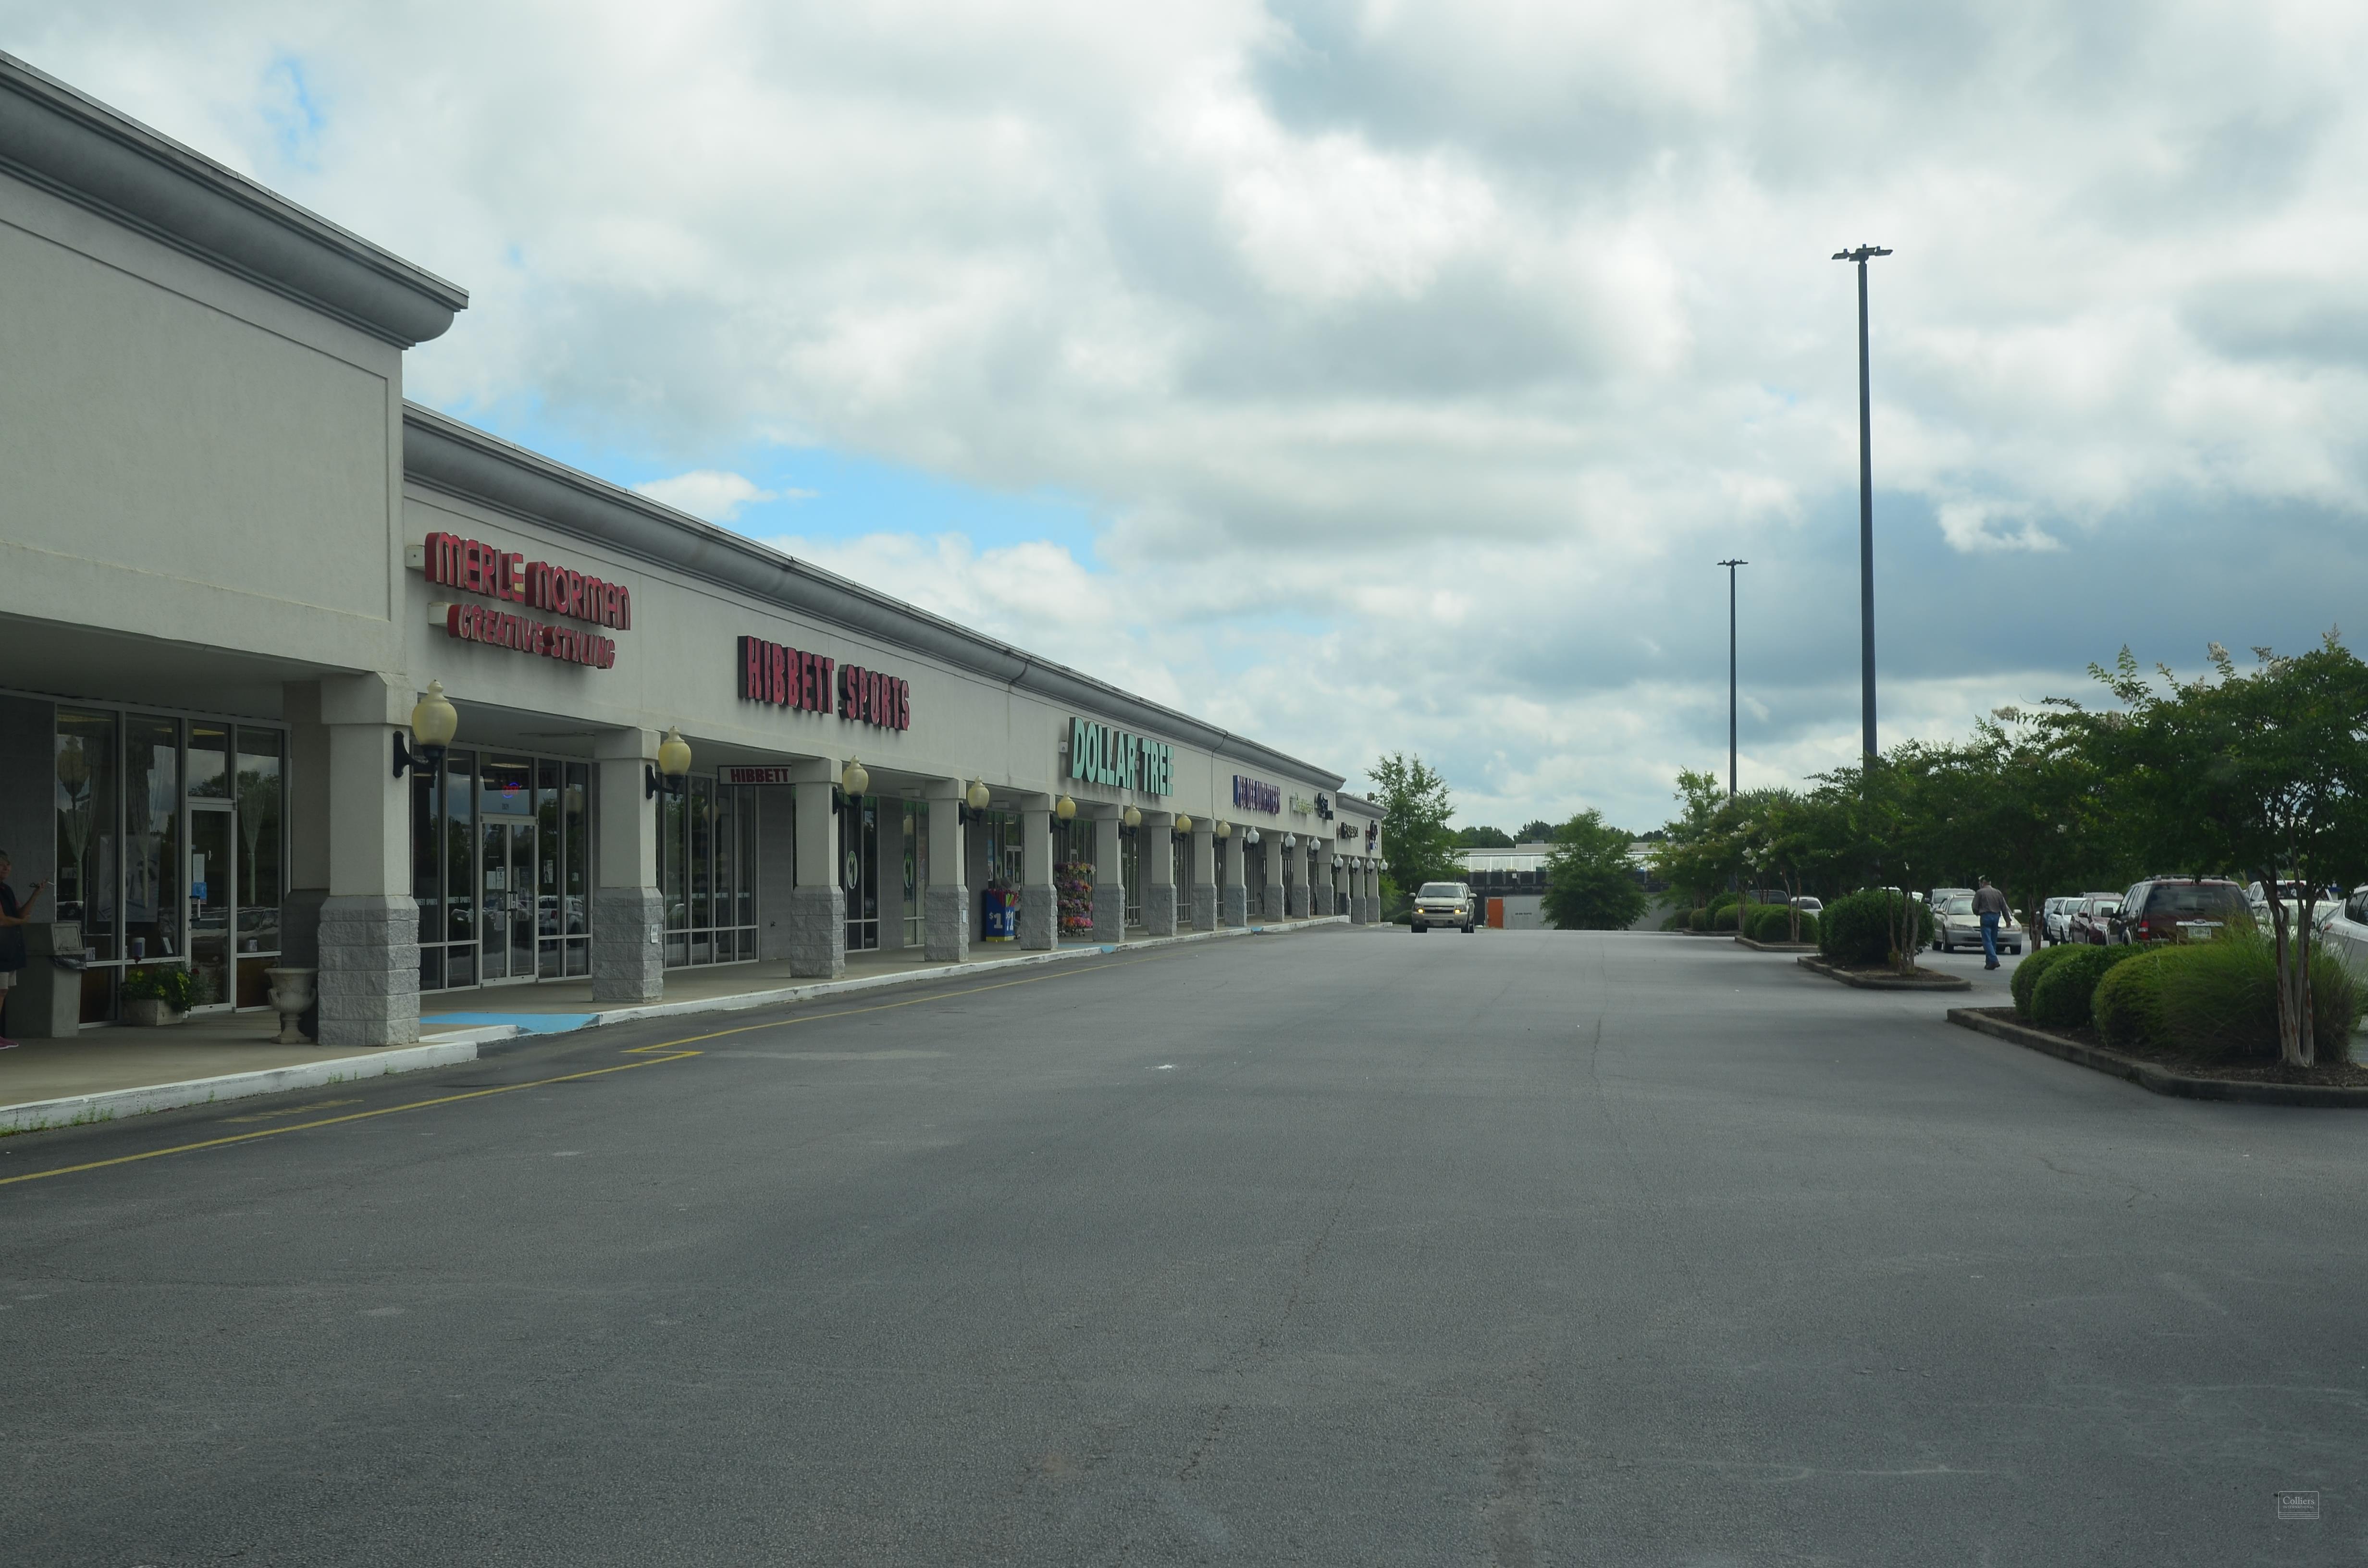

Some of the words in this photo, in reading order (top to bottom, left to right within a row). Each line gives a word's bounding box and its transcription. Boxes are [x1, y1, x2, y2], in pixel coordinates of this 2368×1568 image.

[425, 532, 524, 603] MERLE
[526, 561, 631, 631] NORMAN
[448, 603, 543, 654] CREATIVE
[543, 625, 616, 670] STYLING
[738, 635, 834, 714] HIBBETT
[838, 664, 910, 731] SPORTS
[730, 768, 789, 783] HIBBETT
[1067, 717, 1137, 790] DOLLAR
[1137, 738, 1174, 797] TREE
[989, 911, 1003, 929] $1
